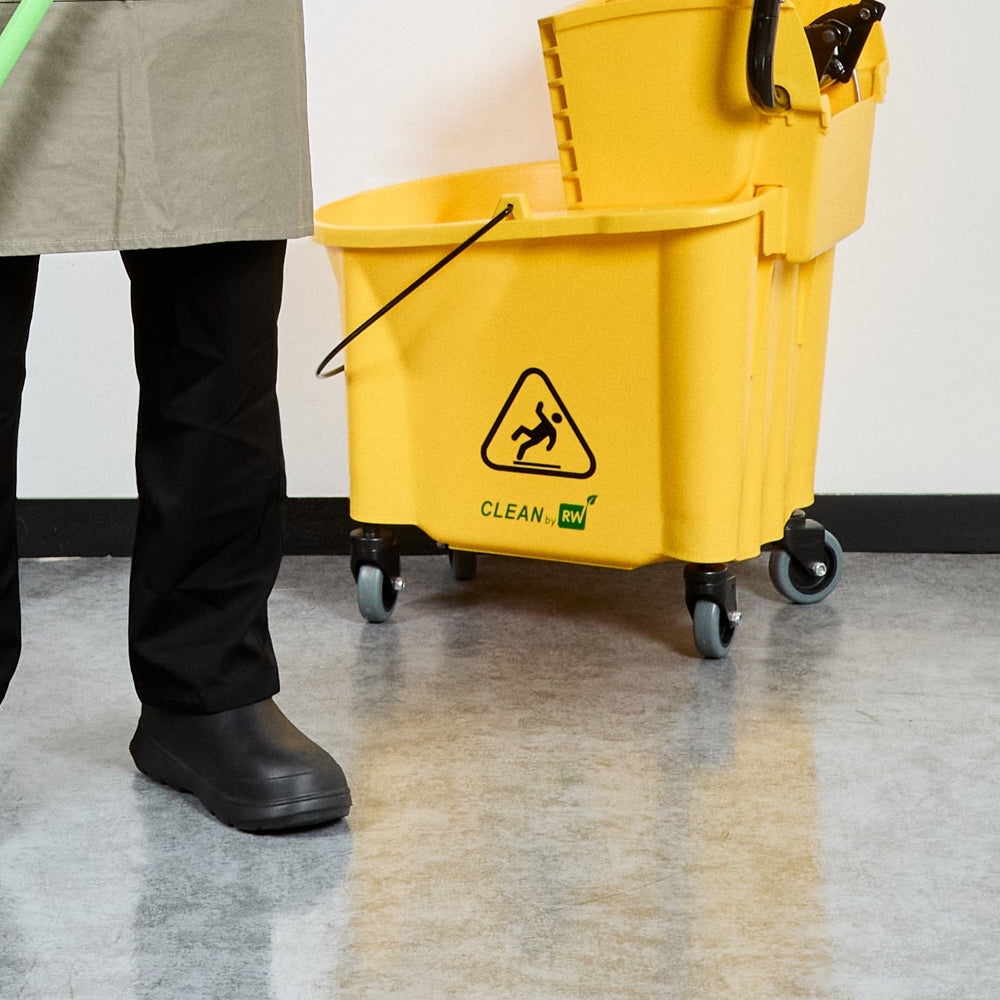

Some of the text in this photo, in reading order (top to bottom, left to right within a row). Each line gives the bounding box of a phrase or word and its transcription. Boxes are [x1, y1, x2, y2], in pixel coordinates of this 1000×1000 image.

[480, 500, 585, 527] CLEAN by RW
